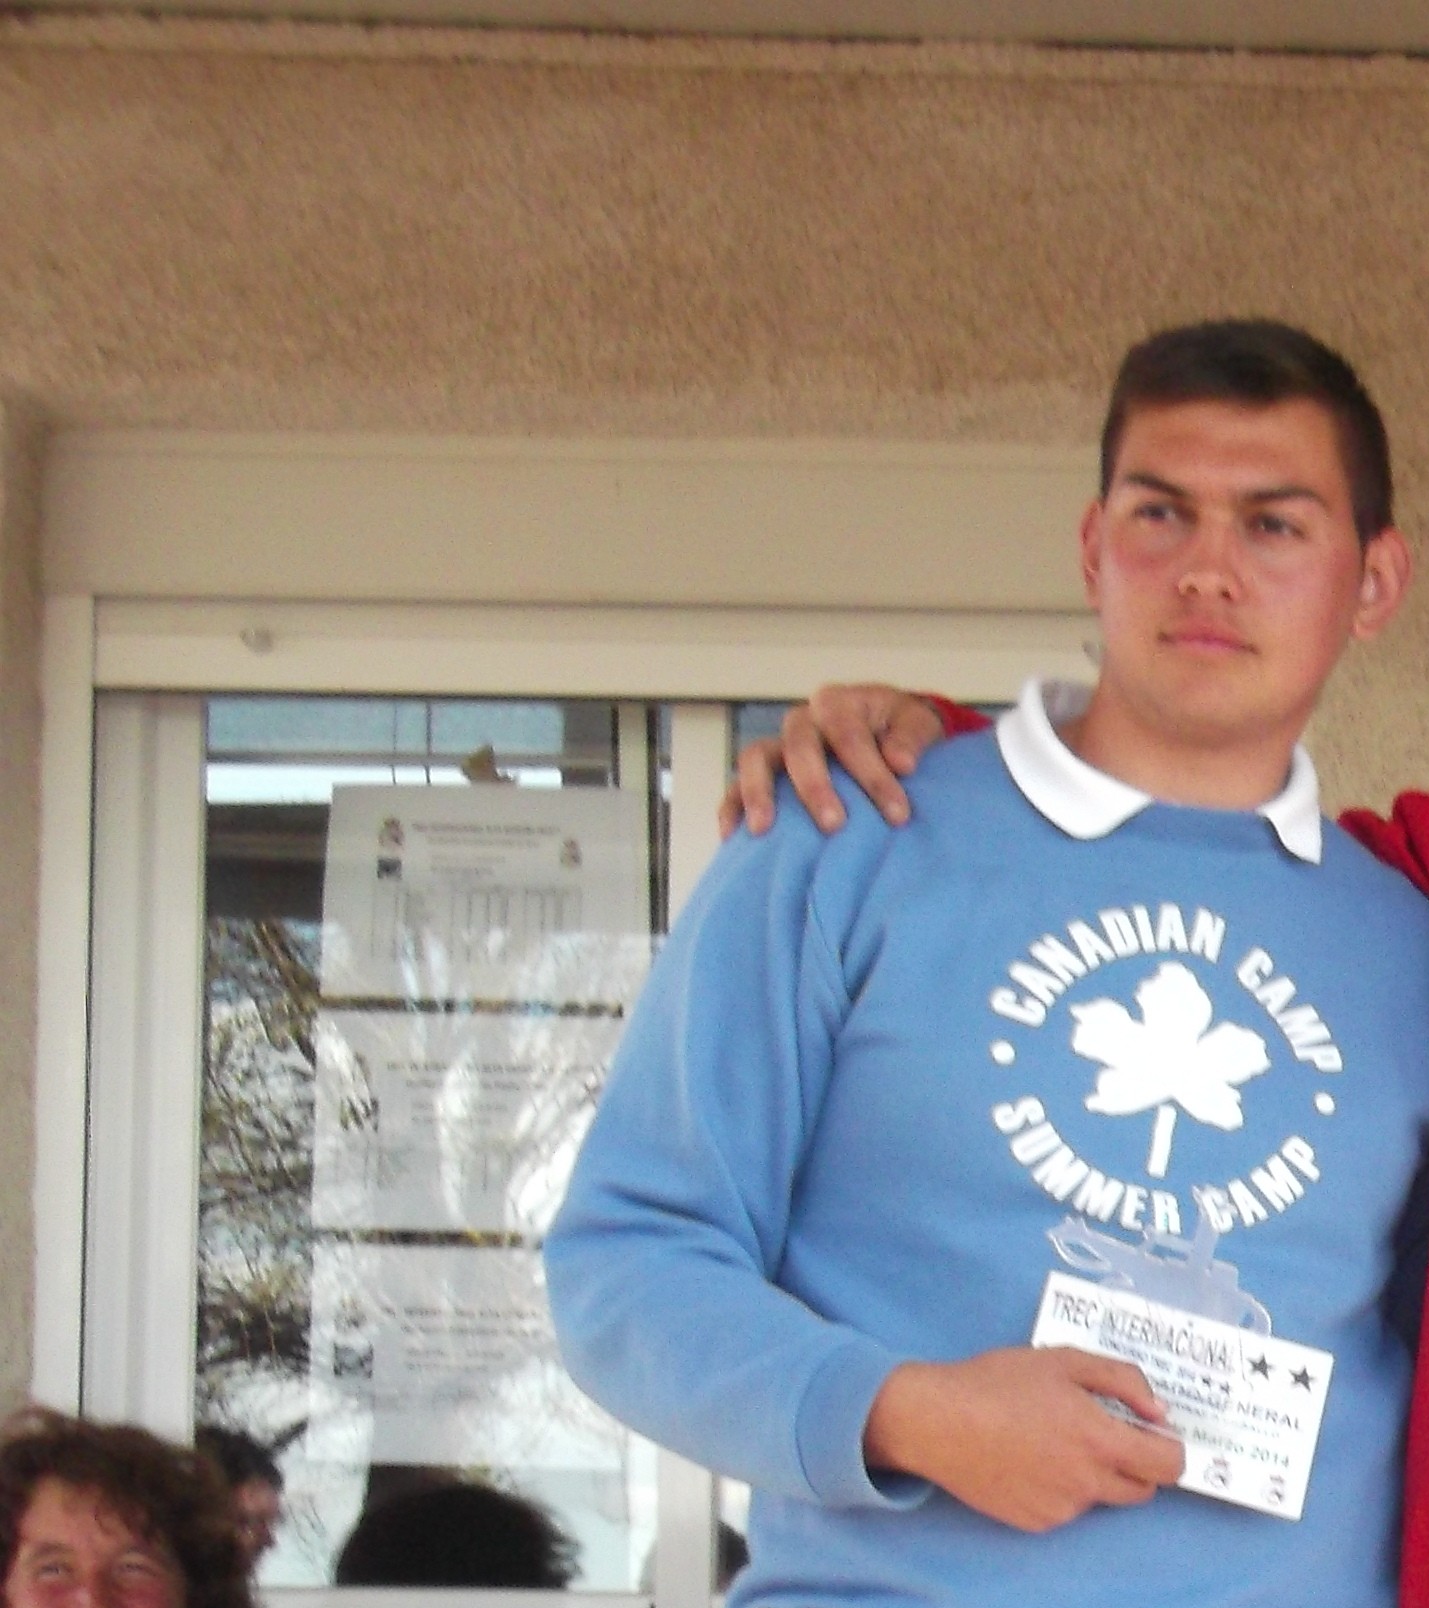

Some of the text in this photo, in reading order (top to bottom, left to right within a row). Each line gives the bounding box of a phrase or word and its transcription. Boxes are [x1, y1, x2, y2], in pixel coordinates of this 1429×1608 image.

[989, 901, 1343, 1073] CANADIAN CAMP
[991, 1095, 1320, 1236] SUMMER CAMP
[1052, 1290, 1099, 1330] TREC
[1249, 1444, 1291, 1470] 2014
